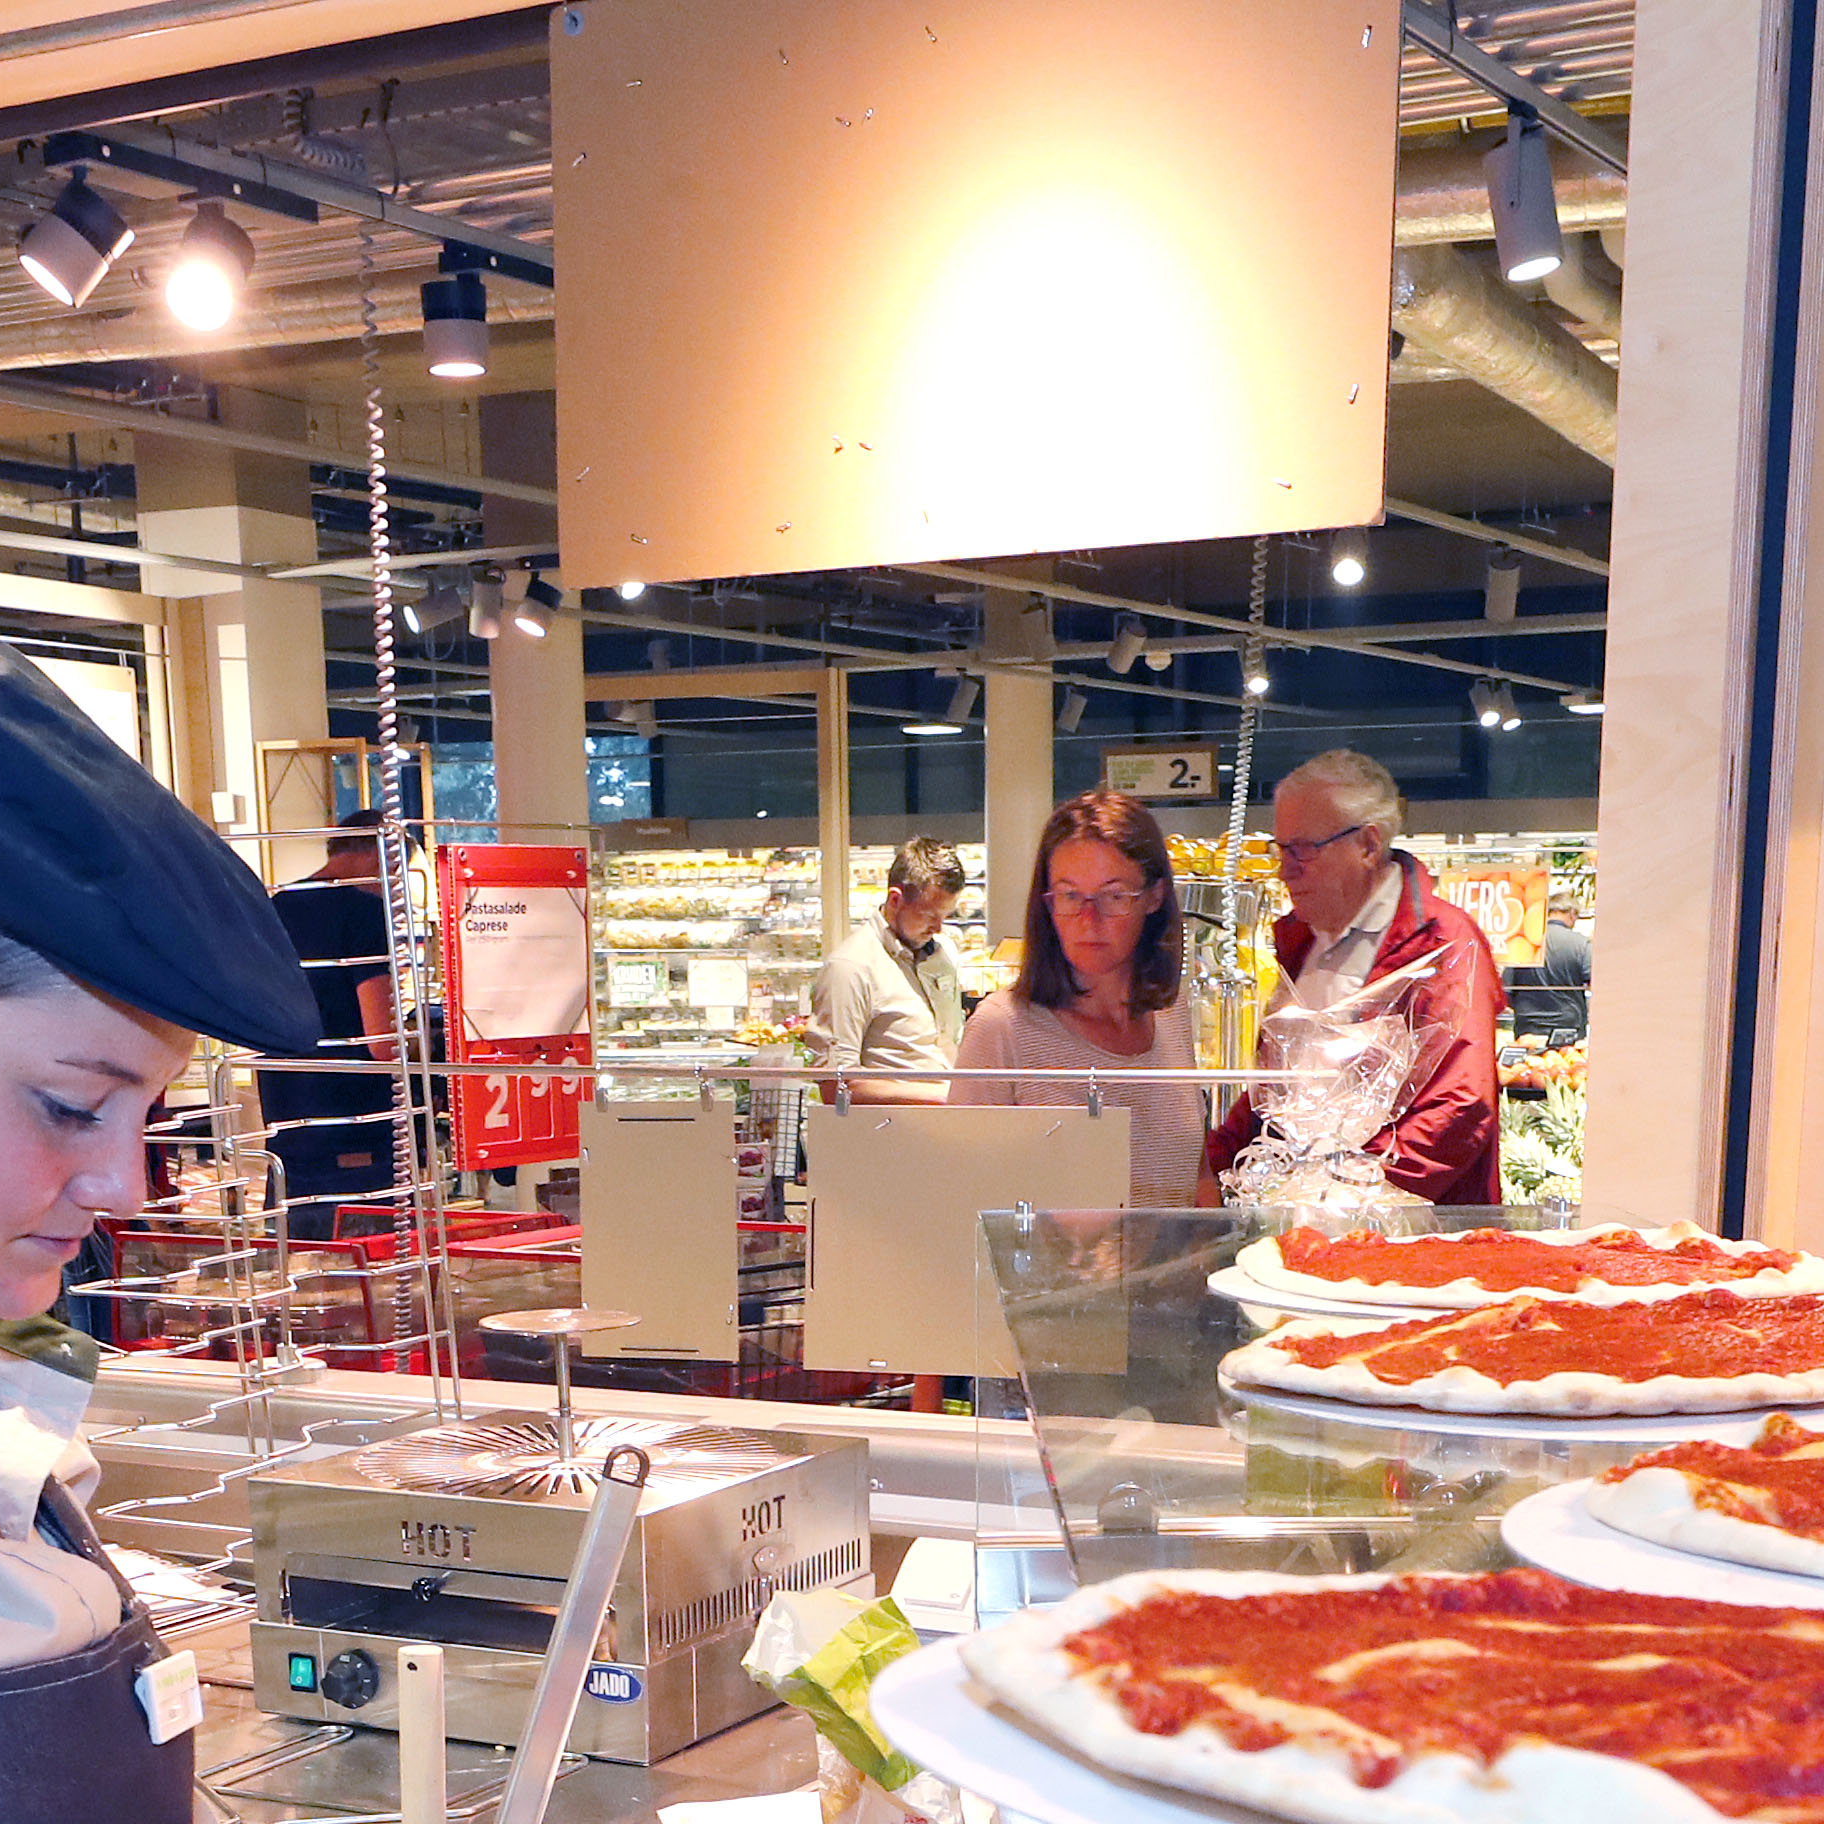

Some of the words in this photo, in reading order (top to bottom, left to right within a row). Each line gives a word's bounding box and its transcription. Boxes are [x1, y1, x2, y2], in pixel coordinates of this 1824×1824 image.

[465, 902, 527, 915] Pastasalade
[466, 920, 508, 933] Caprese
[742, 1494, 787, 1542] HOT
[401, 1520, 476, 1562] HOT
[588, 1670, 631, 1698] JADO
